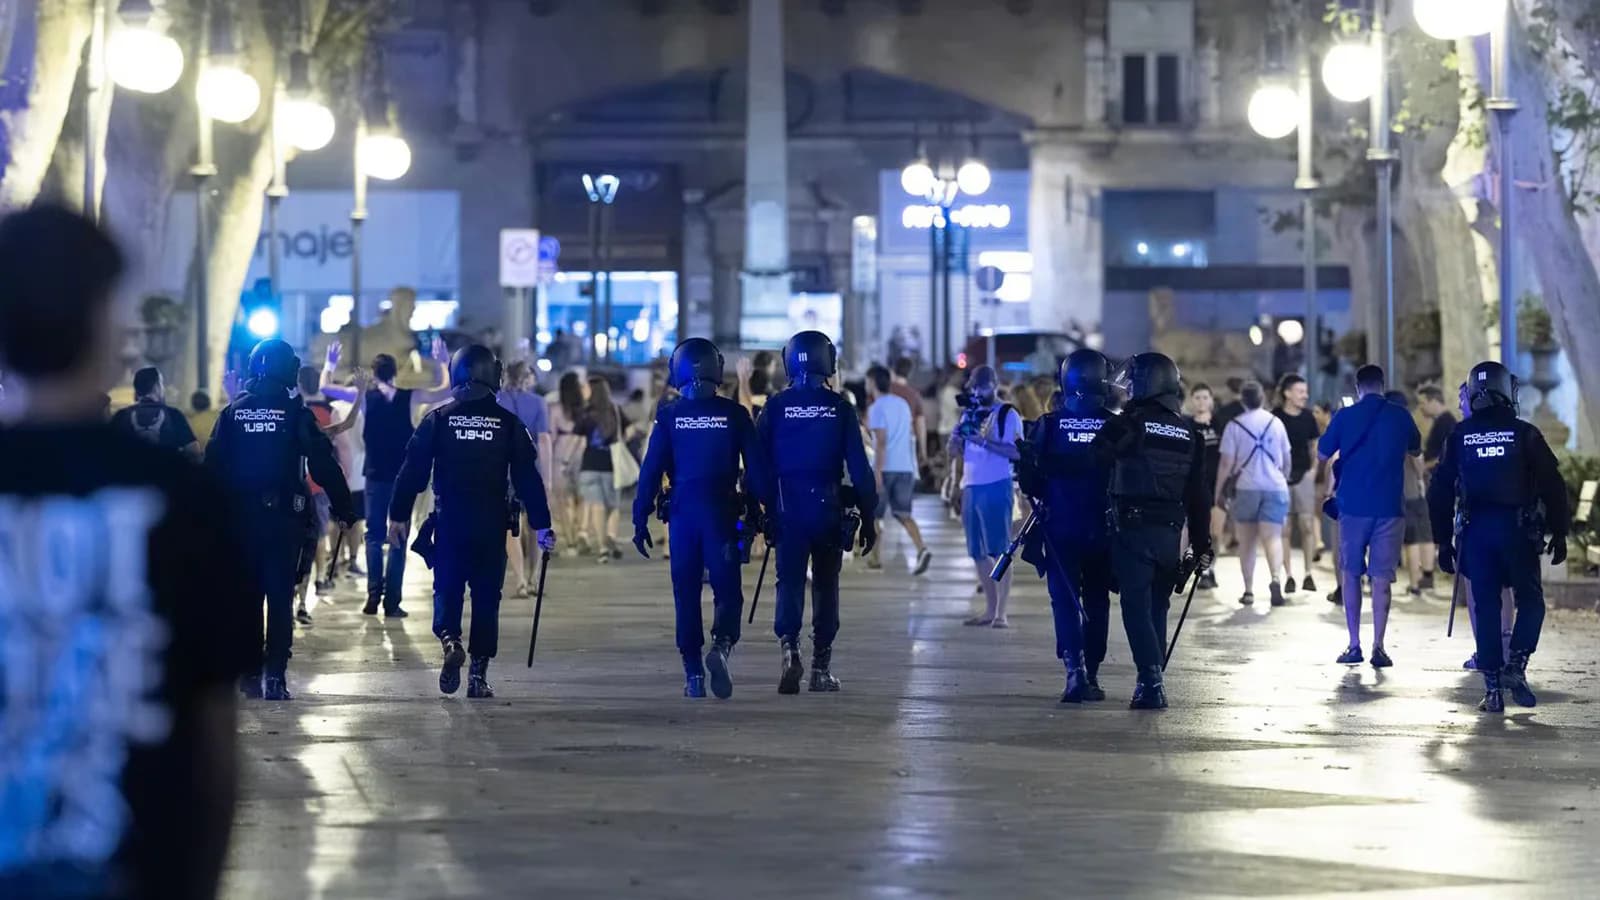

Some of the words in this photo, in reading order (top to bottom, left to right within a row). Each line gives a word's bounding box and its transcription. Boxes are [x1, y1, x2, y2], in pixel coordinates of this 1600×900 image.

[243, 422, 276, 432] 1U910
[448, 420, 501, 429] NACIONAL
[455, 430, 493, 440] 1U940
[1145, 427, 1191, 441] NACIONAL
[1463, 432, 1504, 440] POLICIA
[1463, 437, 1514, 445] NACIONAL
[1476, 446, 1505, 458] 1U90
